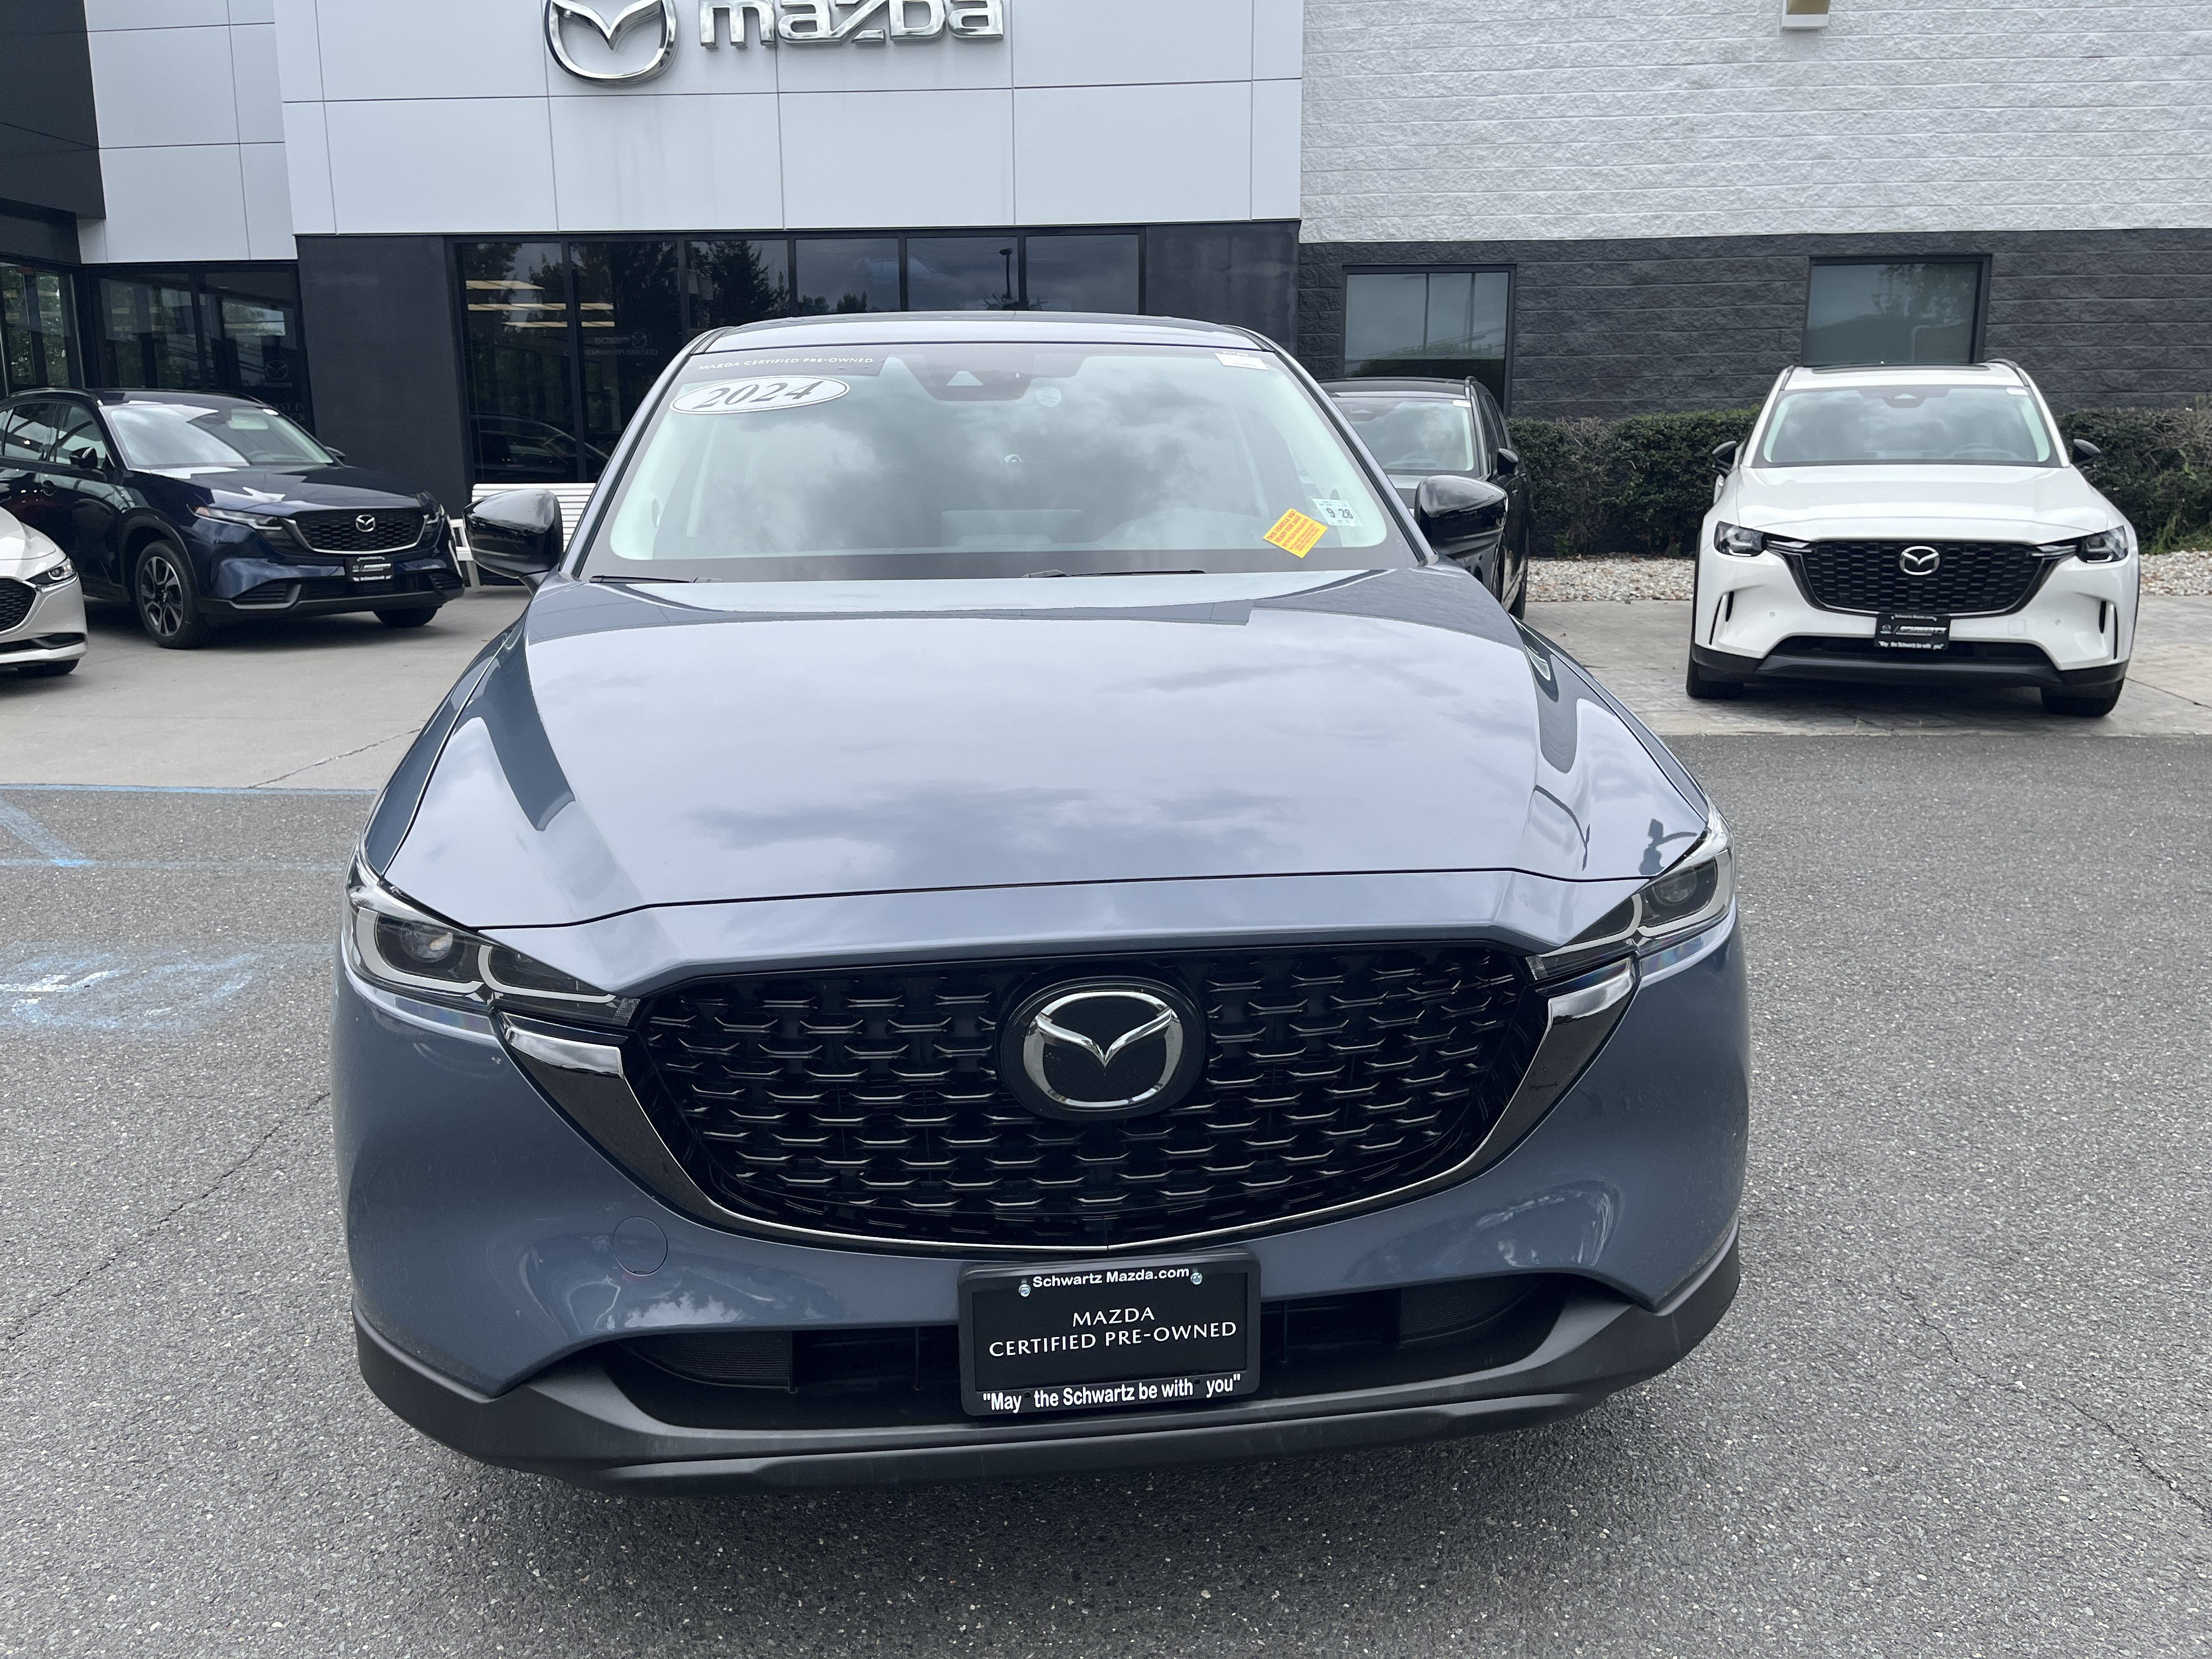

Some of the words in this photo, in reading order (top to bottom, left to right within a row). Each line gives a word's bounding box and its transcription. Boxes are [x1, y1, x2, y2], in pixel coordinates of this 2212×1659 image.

[698, 362, 740, 370] MAZDA
[691, 380, 825, 410] 2024
[1326, 507, 1336, 518] 9
[1338, 509, 1353, 519] 28
[1032, 1273, 1102, 1288] Schwartz
[1106, 1267, 1190, 1283] Mazda.com
[1073, 1307, 1155, 1327] MAZDA
[989, 1334, 1096, 1357] CERTIFIED
[1105, 1321, 1237, 1346] PRE-OWNED
[983, 1392, 1022, 1413] "May
[1034, 1390, 1059, 1408] the
[1063, 1386, 1135, 1406] Schwartz
[1138, 1382, 1158, 1399] be
[1161, 1378, 1193, 1397] with
[1206, 1374, 1241, 1398] you"
